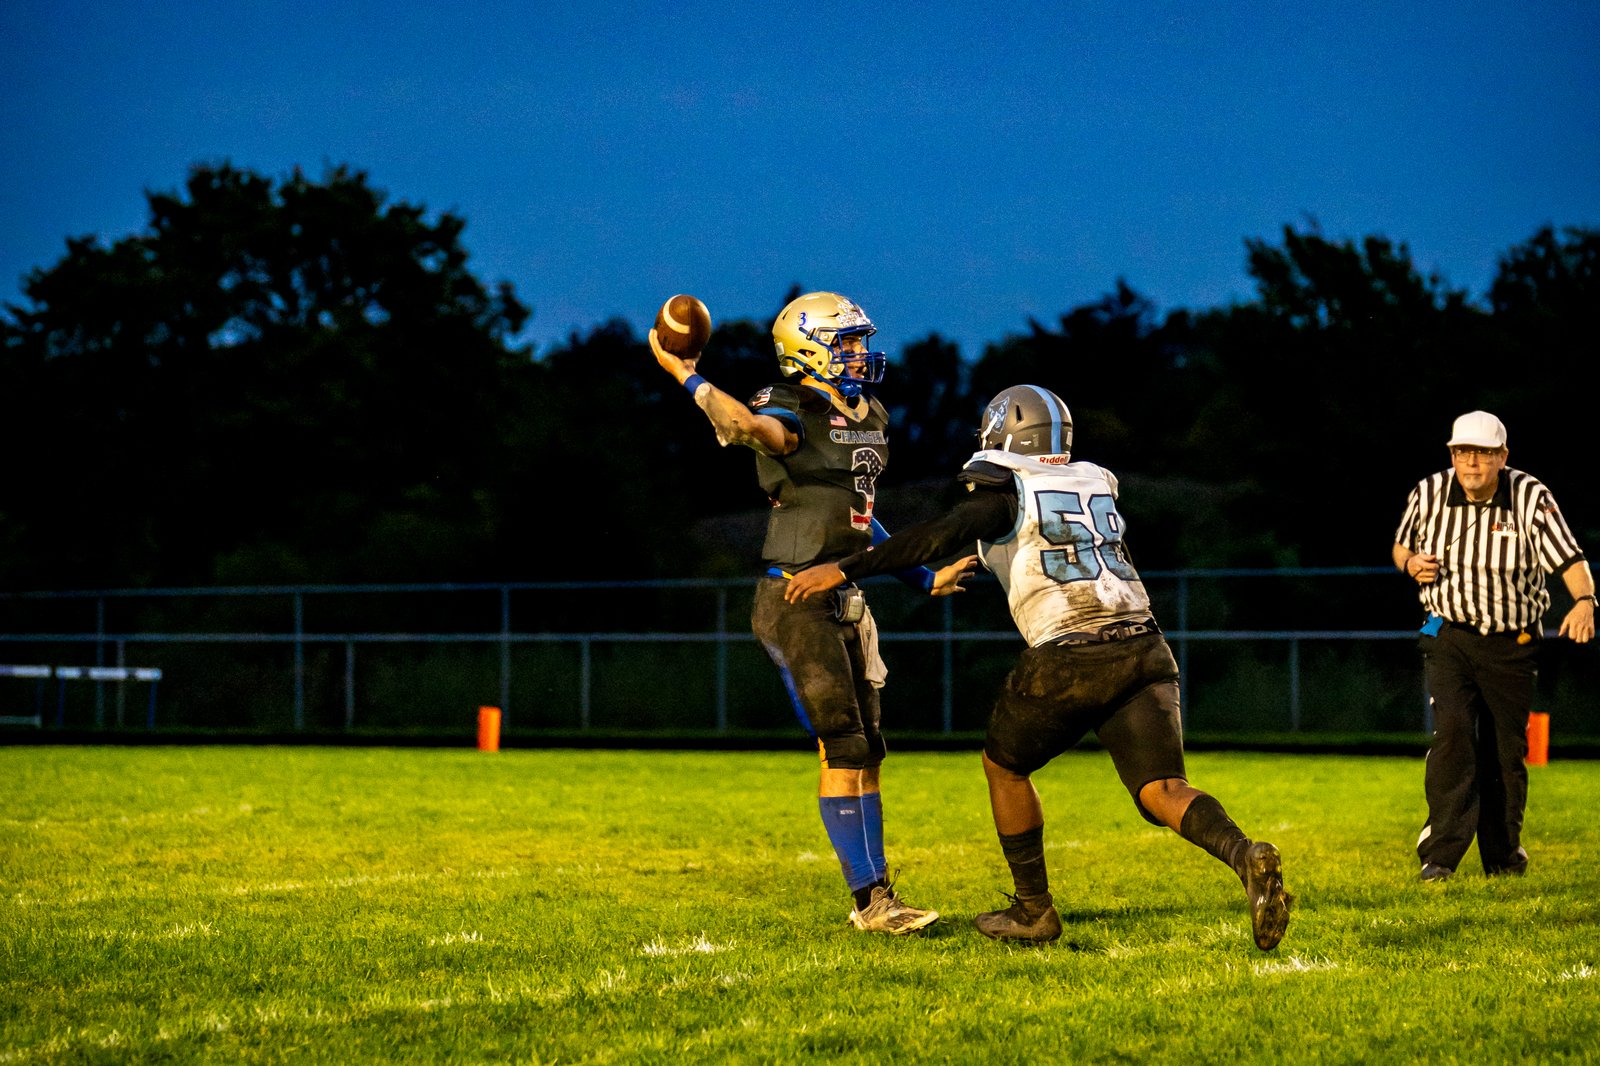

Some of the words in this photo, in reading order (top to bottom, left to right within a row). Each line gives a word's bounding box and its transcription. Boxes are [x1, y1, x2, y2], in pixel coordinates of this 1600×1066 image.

[798, 312, 807, 326] 3
[849, 447, 883, 531] 3
[1034, 490, 1141, 584] 58
